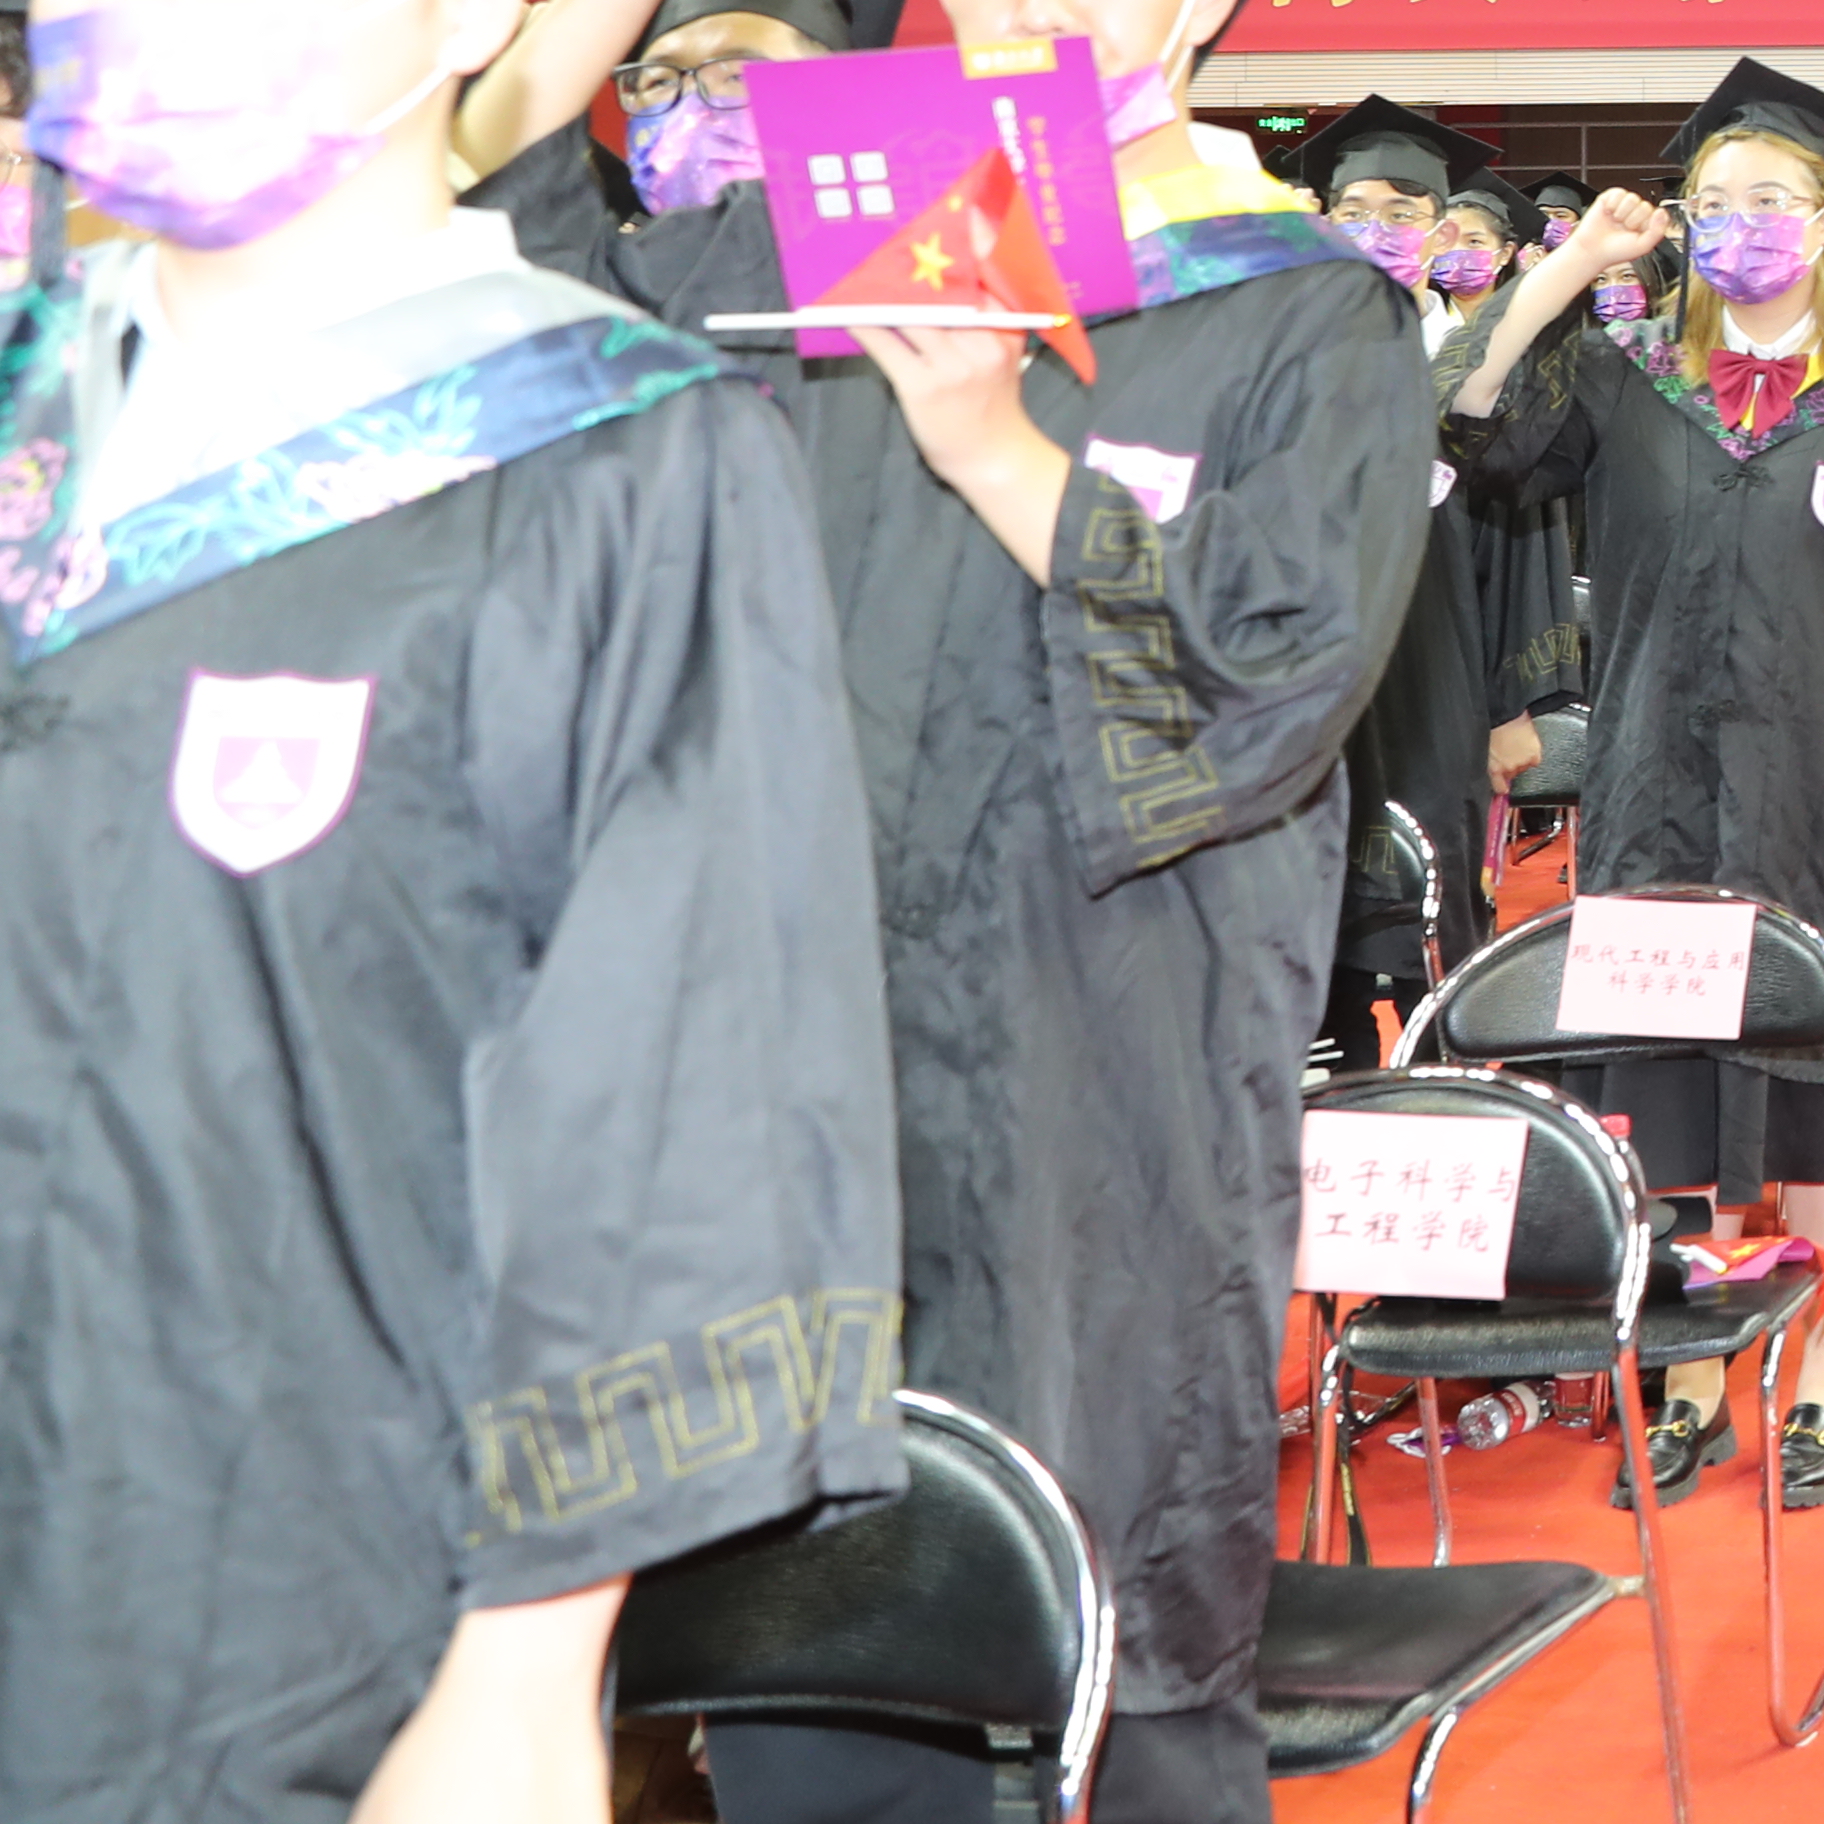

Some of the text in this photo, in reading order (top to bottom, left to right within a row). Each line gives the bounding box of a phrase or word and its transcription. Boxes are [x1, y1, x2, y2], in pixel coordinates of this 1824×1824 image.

[1570, 943, 1745, 972] 现代工程与应用
[1607, 969, 1708, 997] 科学学院
[1304, 1157, 1517, 1203] 电子科学与
[1314, 1211, 1490, 1253] 工程学院
